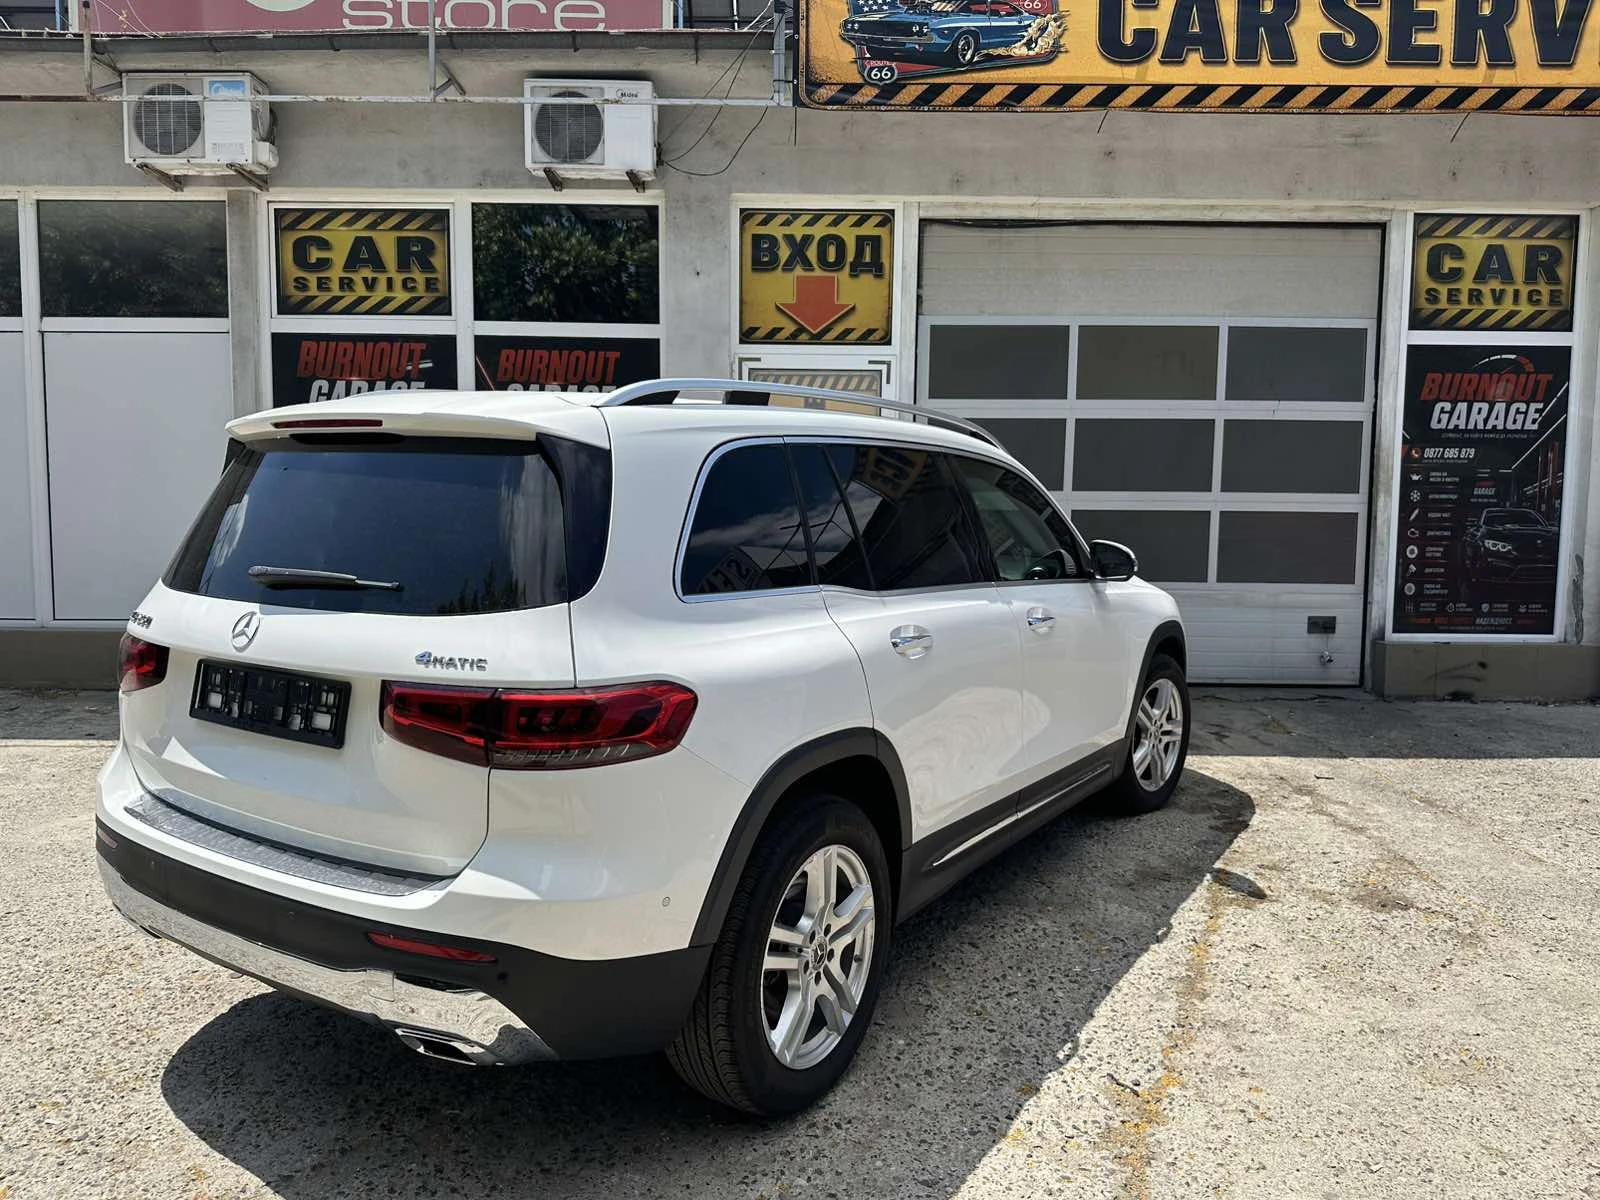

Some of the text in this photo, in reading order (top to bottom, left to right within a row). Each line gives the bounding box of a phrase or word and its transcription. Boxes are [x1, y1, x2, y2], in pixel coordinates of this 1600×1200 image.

[1097, 0, 1594, 66] CAR SERV
[870, 67, 892, 80] 66
[291, 235, 438, 273] CAR
[750, 233, 884, 278] ВХОД
[1426, 242, 1563, 285] CAR
[292, 275, 441, 294] SERVICE
[1424, 287, 1563, 306] SERVICE
[297, 340, 428, 379] BURNOUT
[497, 349, 621, 385] BURNOUT
[1420, 372, 1553, 401] BURNOUT
[1430, 401, 1544, 430] GARAGE
[1424, 448, 1442, 458] 0877
[415, 651, 488, 672] 4MATIC
